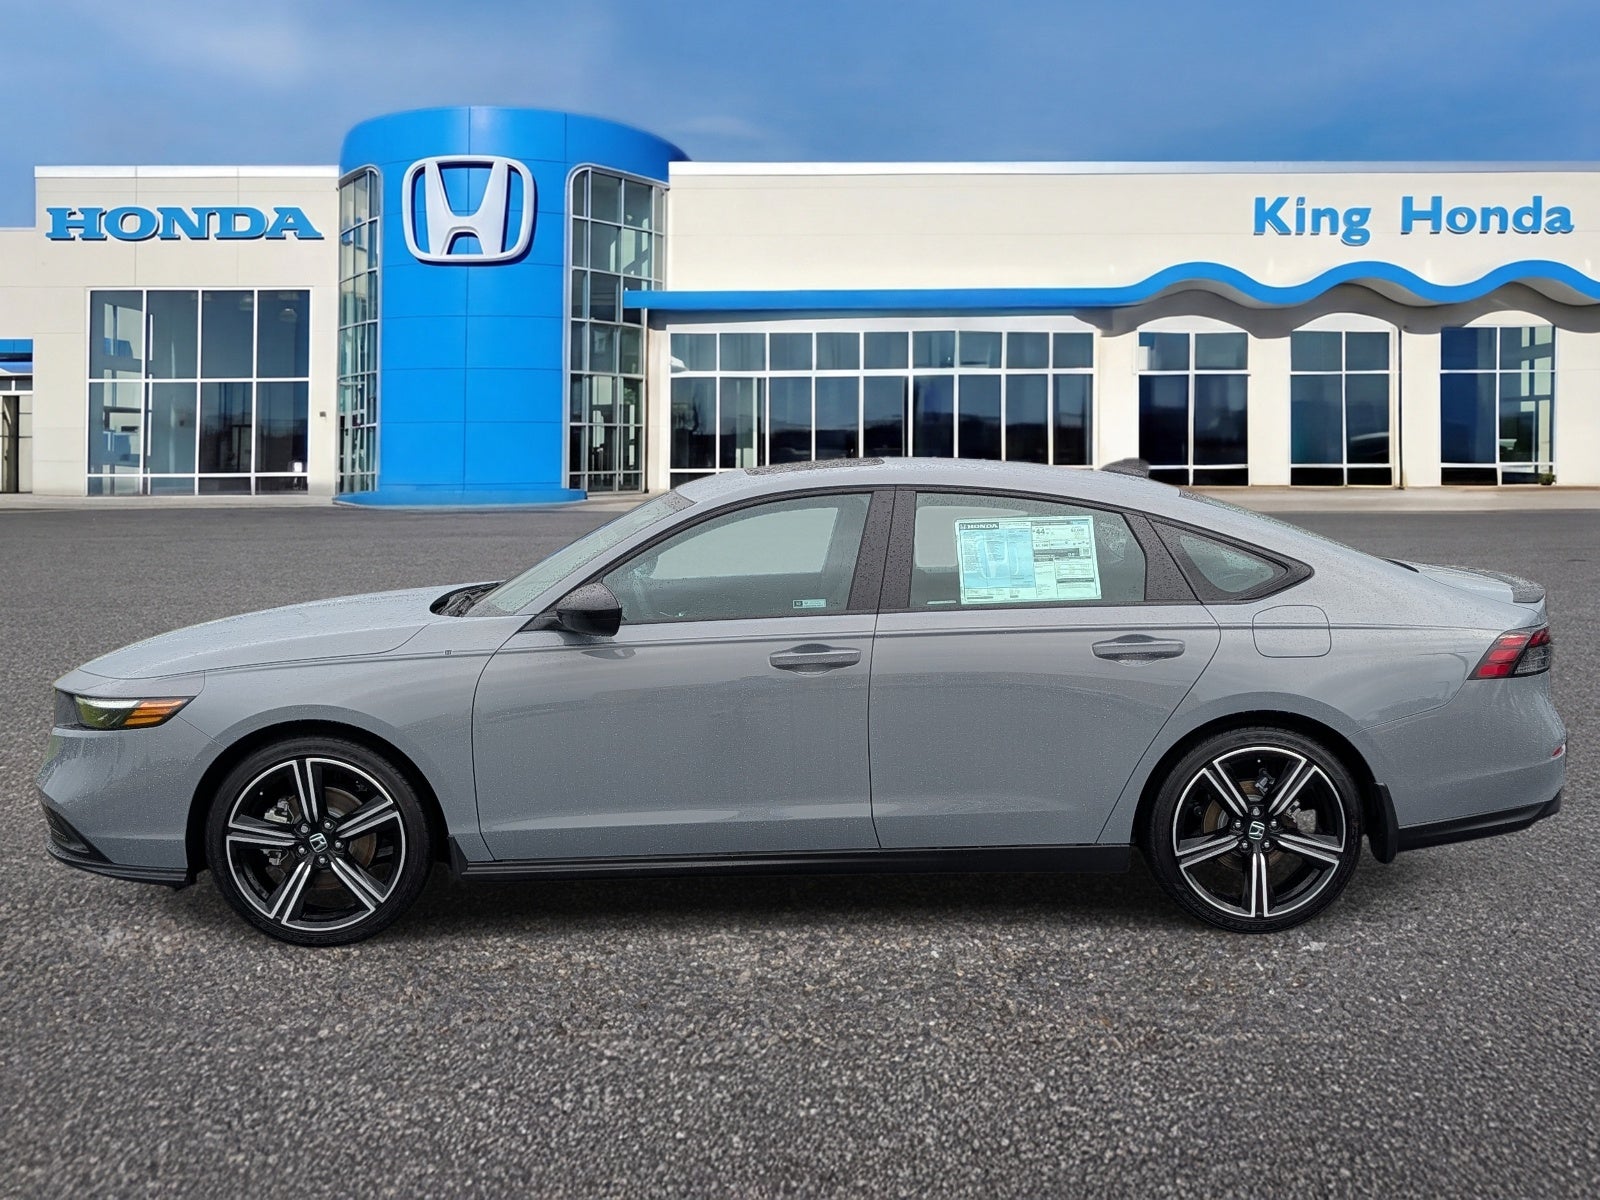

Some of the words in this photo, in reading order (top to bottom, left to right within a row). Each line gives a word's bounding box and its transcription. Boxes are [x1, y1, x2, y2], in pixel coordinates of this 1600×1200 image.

[46, 206, 323, 241] HONDA
[1253, 196, 1371, 246] King
[1401, 196, 1574, 234] Honda
